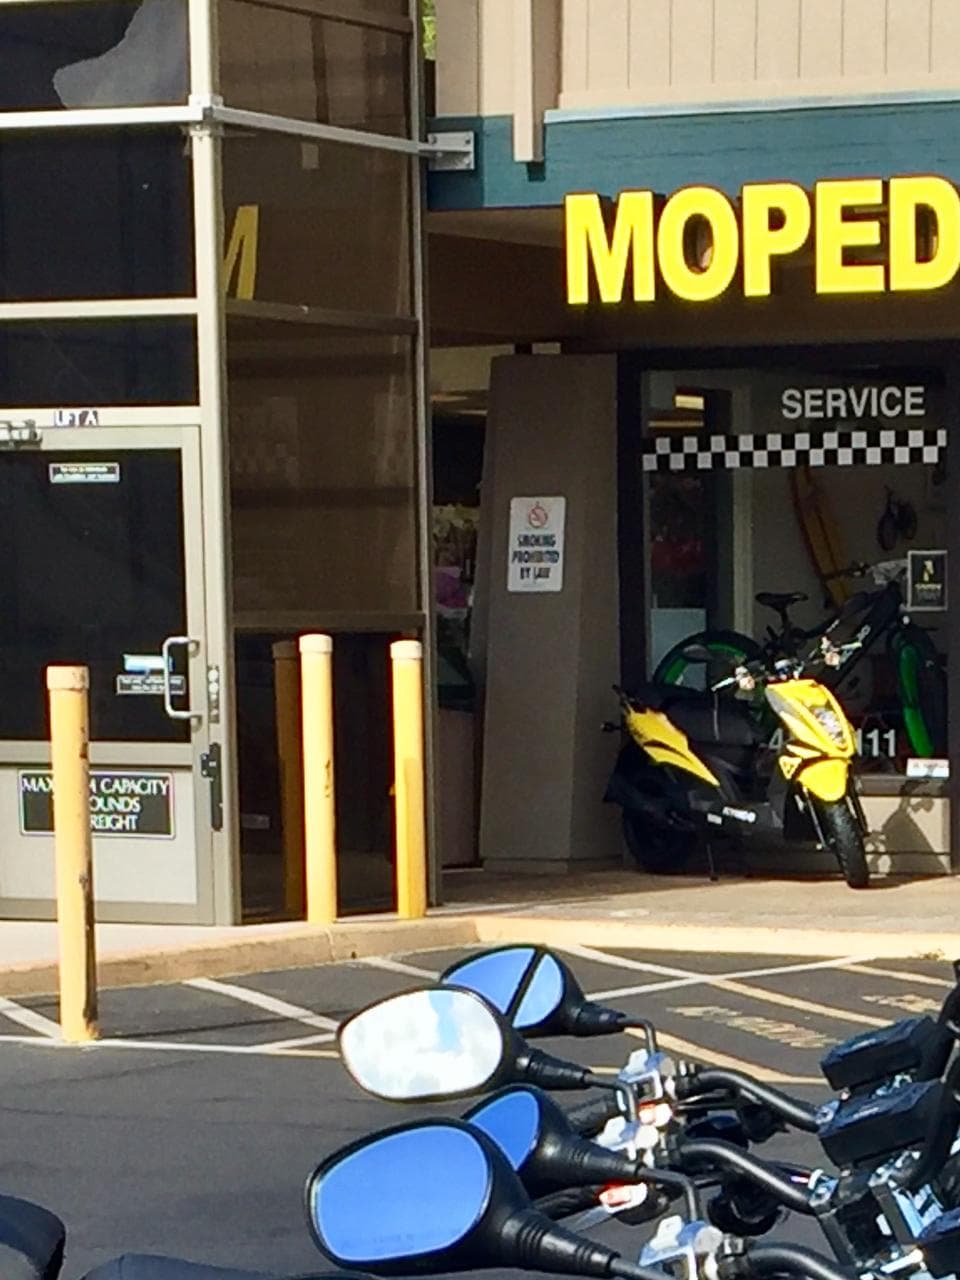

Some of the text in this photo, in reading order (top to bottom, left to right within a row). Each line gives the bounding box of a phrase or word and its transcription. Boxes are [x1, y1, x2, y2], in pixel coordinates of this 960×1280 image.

[781, 386, 926, 419] SERVICE
[100, 777, 169, 796] CAPACITY
[90, 795, 141, 812] OUNDS
[90, 813, 138, 830] REIGHT
